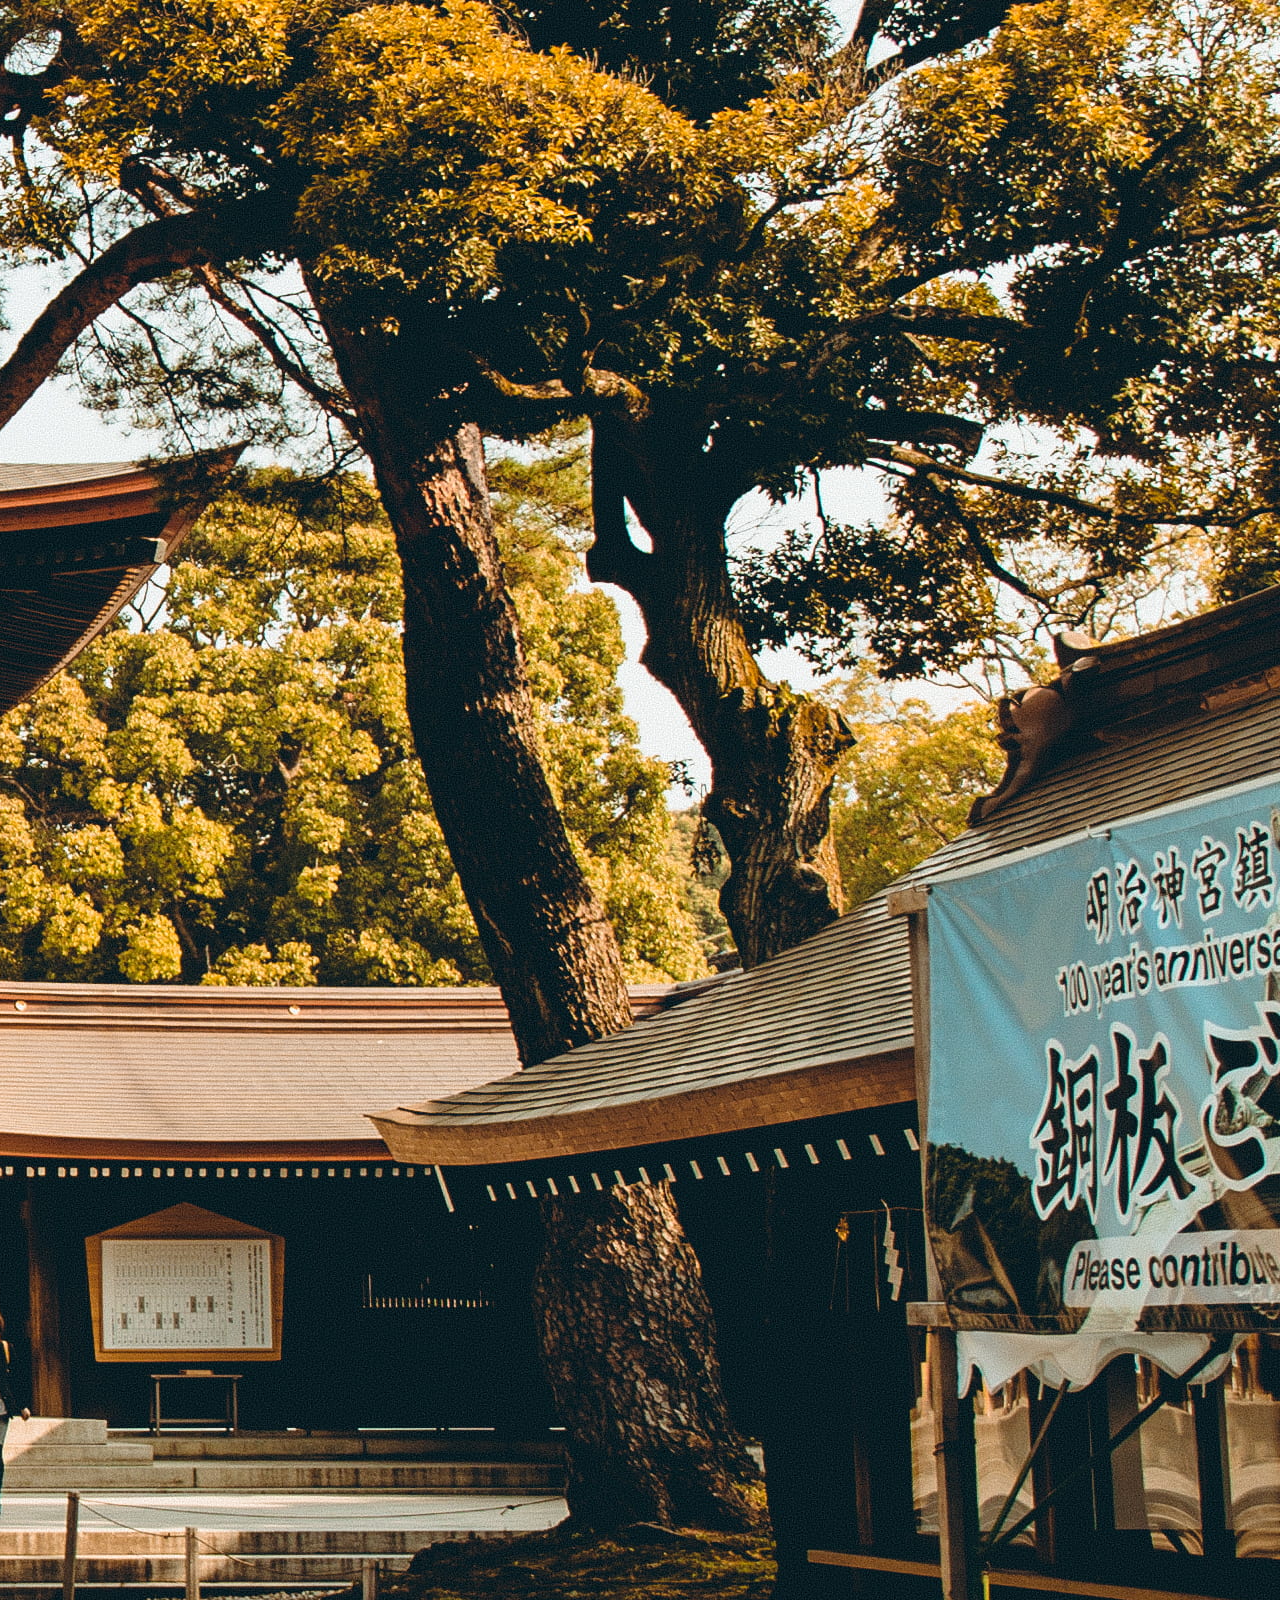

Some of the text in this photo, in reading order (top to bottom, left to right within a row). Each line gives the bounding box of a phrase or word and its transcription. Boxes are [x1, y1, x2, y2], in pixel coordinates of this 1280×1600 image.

[1086, 826, 1274, 942] 明治神宮鎮
[1058, 963, 1090, 1013] 100
[1092, 947, 1150, 1015] year's
[1069, 1241, 1280, 1292] Please contribute
